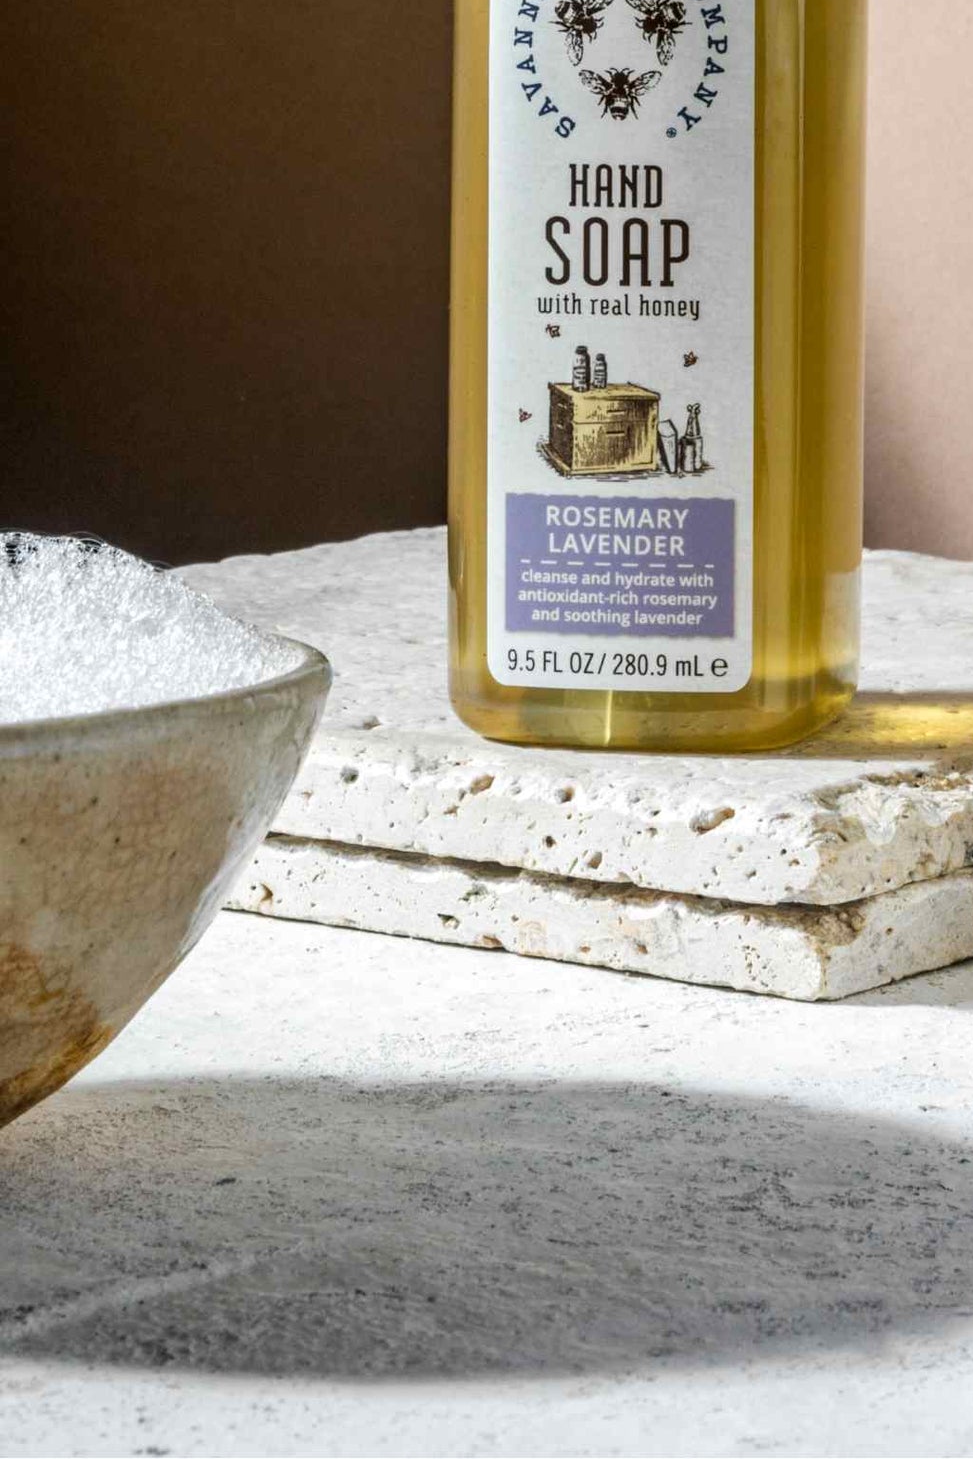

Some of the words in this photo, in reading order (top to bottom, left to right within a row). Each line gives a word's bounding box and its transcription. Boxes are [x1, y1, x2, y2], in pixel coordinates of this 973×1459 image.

[569, 163, 663, 209] HAND
[545, 215, 690, 287] SOAP
[537, 293, 582, 315] with
[590, 294, 631, 316] real
[639, 294, 700, 321] honey
[546, 505, 689, 529] ROSEMARY
[548, 533, 685, 556] LAVENDER
[521, 569, 577, 584] cleanse
[581, 570, 611, 585] and
[615, 571, 675, 590] hydrate
[679, 573, 714, 587] with
[518, 588, 638, 605] antioxidant-rich
[643, 593, 717, 610] rosemary
[531, 608, 560, 622] and
[564, 609, 631, 627] soothing
[634, 611, 703, 625] lavender
[507, 648, 535, 672] 9.5
[543, 650, 563, 673] FL
[675, 655, 704, 677] mL
